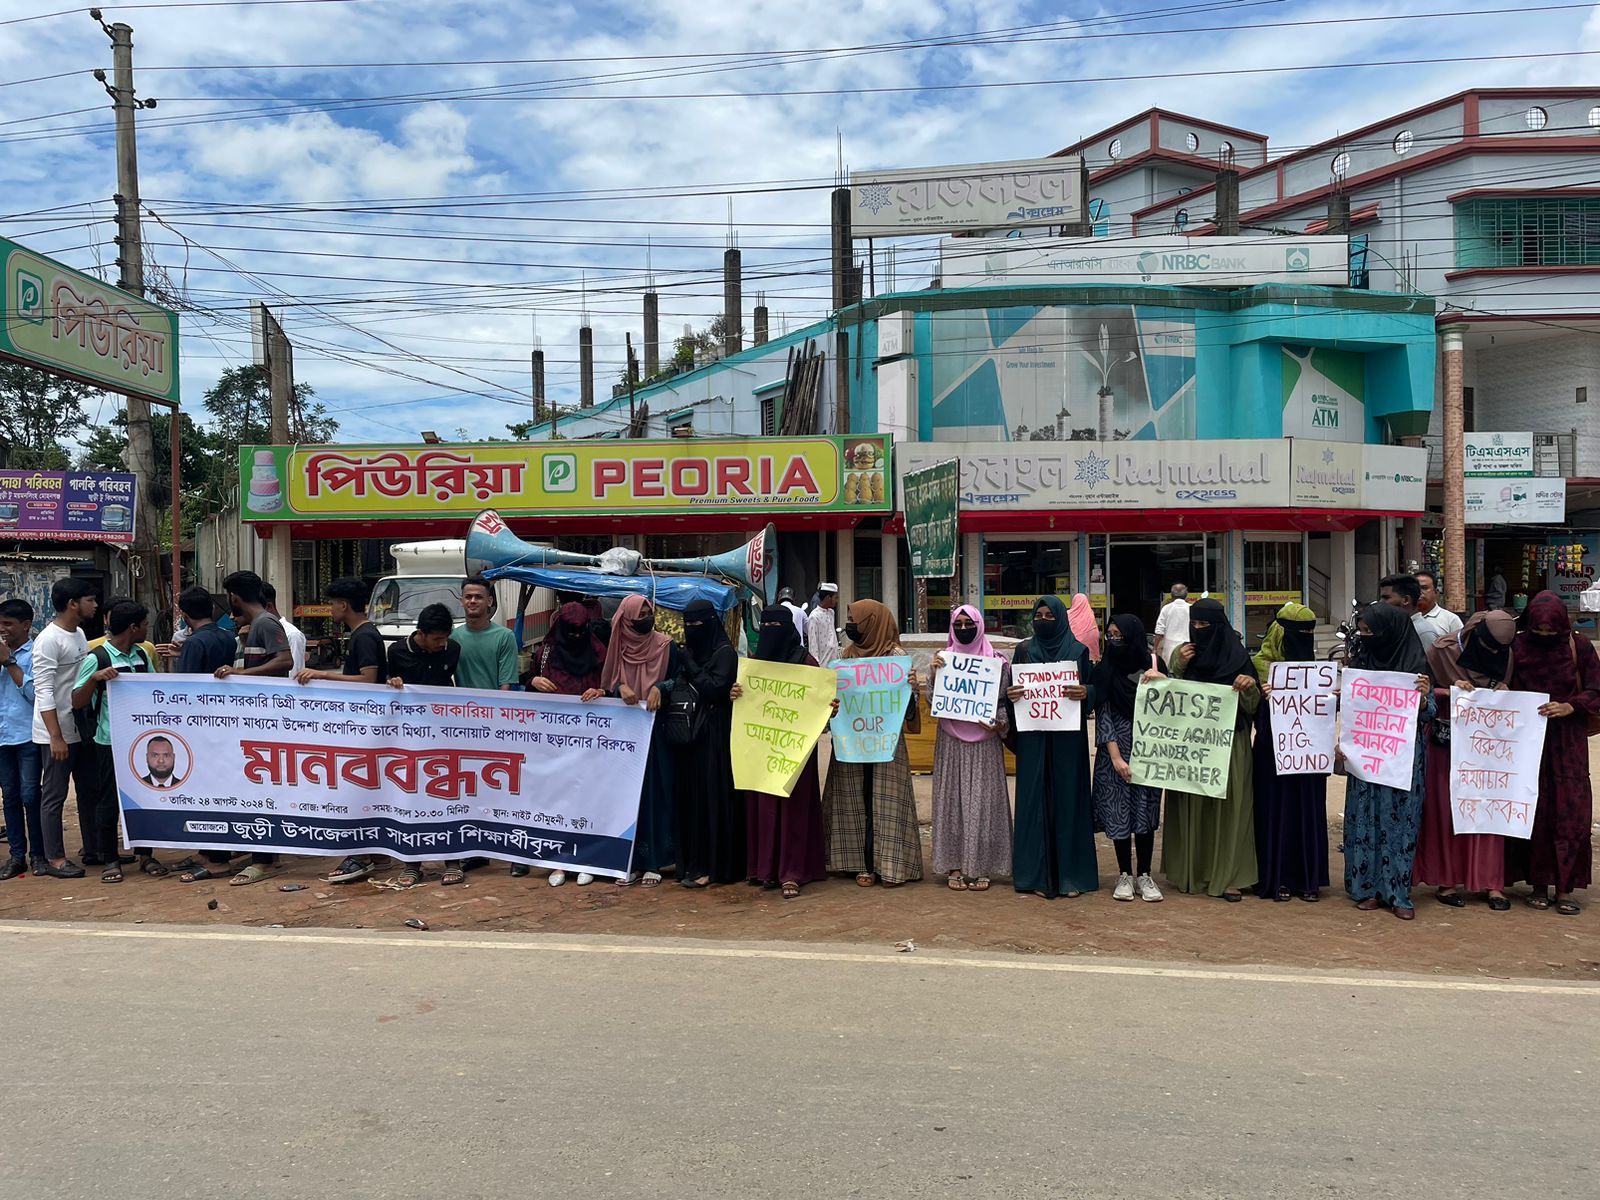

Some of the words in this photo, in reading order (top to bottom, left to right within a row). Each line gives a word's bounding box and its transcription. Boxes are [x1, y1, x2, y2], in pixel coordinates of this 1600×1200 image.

[1048, 257, 1102, 269] এনআরবিসি
[1162, 254, 1210, 270] NRBC
[1211, 257, 1246, 270] BANK
[51, 282, 164, 376] পিউরিয়া
[882, 338, 898, 353] ATM
[1312, 408, 1339, 427] ATM
[1465, 444, 1530, 457] টিএমএসএস
[25, 473, 62, 489] পরিবহন
[70, 476, 96, 491] পালকি
[99, 477, 131, 492] পরিবহন
[306, 452, 525, 500] পিউরিয়া
[593, 457, 819, 497] PEORIA
[1113, 452, 1271, 494] Rajmahal
[836, 662, 904, 690] STAND
[952, 655, 982, 675] WE
[1018, 671, 1051, 684] STAND
[1052, 670, 1080, 682] WITH
[1271, 664, 1333, 691] LET'S
[746, 675, 812, 701] আমাদের
[943, 675, 994, 697] WANT
[1350, 677, 1419, 709] মিথ্যাচার
[152, 689, 192, 705] টি.এন.
[197, 694, 225, 706] খানম
[229, 693, 268, 708] সরকারি
[272, 693, 296, 710] ডিগ্রী
[299, 699, 345, 713] কলেজের
[348, 699, 386, 716] জনপ্রিয়
[390, 701, 426, 717] শিক্ষক
[430, 701, 495, 719] জাকারিয়া
[500, 706, 537, 724] মাসুদ
[540, 711, 581, 726] স্যারকে
[586, 712, 612, 728] নিয়ে
[763, 699, 800, 724] শিক্ষক
[841, 690, 901, 714] WITH
[935, 694, 993, 718] JUSTICE
[1029, 701, 1062, 720] SIR
[1143, 687, 1222, 721] RAISE
[1271, 694, 1329, 716] MAKE
[131, 711, 182, 727] সামাজিক
[186, 713, 238, 728] যোগাযোগ
[243, 717, 278, 730] মাধ্যমে
[282, 715, 318, 733] উদ্দেশ্য
[322, 721, 367, 737] প্রণোদিত
[371, 724, 398, 737] ভাবে
[402, 723, 435, 739] মিথ্যা,
[440, 724, 490, 739] বানোয়াট
[546, 733, 593, 749] ছড়ানোর
[597, 736, 636, 753] বিরুদ্ধে
[853, 716, 884, 733] OUR
[1291, 716, 1303, 730] A
[1354, 706, 1408, 734] মানিনা
[744, 722, 808, 752] আমাদের
[1136, 720, 1179, 740] VOICE
[1184, 727, 1235, 748] AGAINST
[1278, 731, 1313, 751] BIG
[1350, 729, 1407, 756] মানবো
[1470, 729, 1519, 763] বিরুদ্ধে
[1132, 740, 1189, 762] SLANDER
[1191, 748, 1210, 764] OF
[1276, 753, 1330, 771] SOUND
[1361, 754, 1385, 775] না
[240, 739, 525, 799] মানববন্ধন
[1139, 760, 1221, 786] TEACHER
[1457, 761, 1519, 790] মিথ্যাচার
[169, 794, 195, 806] তারিখ:
[198, 797, 210, 806] ২৪
[212, 796, 238, 807] আগস্ট
[240, 799, 263, 809] ২০২৪
[298, 802, 319, 812] রোজ:
[321, 802, 348, 814] শনিবার
[372, 804, 393, 814] সময়:
[414, 808, 443, 818] ১০.৩০
[446, 804, 470, 817] মিনিট
[491, 808, 509, 819] স্থান:
[511, 810, 532, 822] নাইট
[533, 811, 568, 828] চৌমুহনী,
[570, 817, 588, 830] জুড়ী
[1457, 798, 1482, 823] বন্ধ
[1486, 798, 1532, 824] করুন
[189, 822, 227, 832] আয়োজনে:
[231, 817, 275, 840] জুড়ী
[281, 820, 380, 842] উপজেলার
[386, 826, 453, 847] সাধারণ
[458, 824, 565, 858] শিক্ষার্থীবৃন্দ
